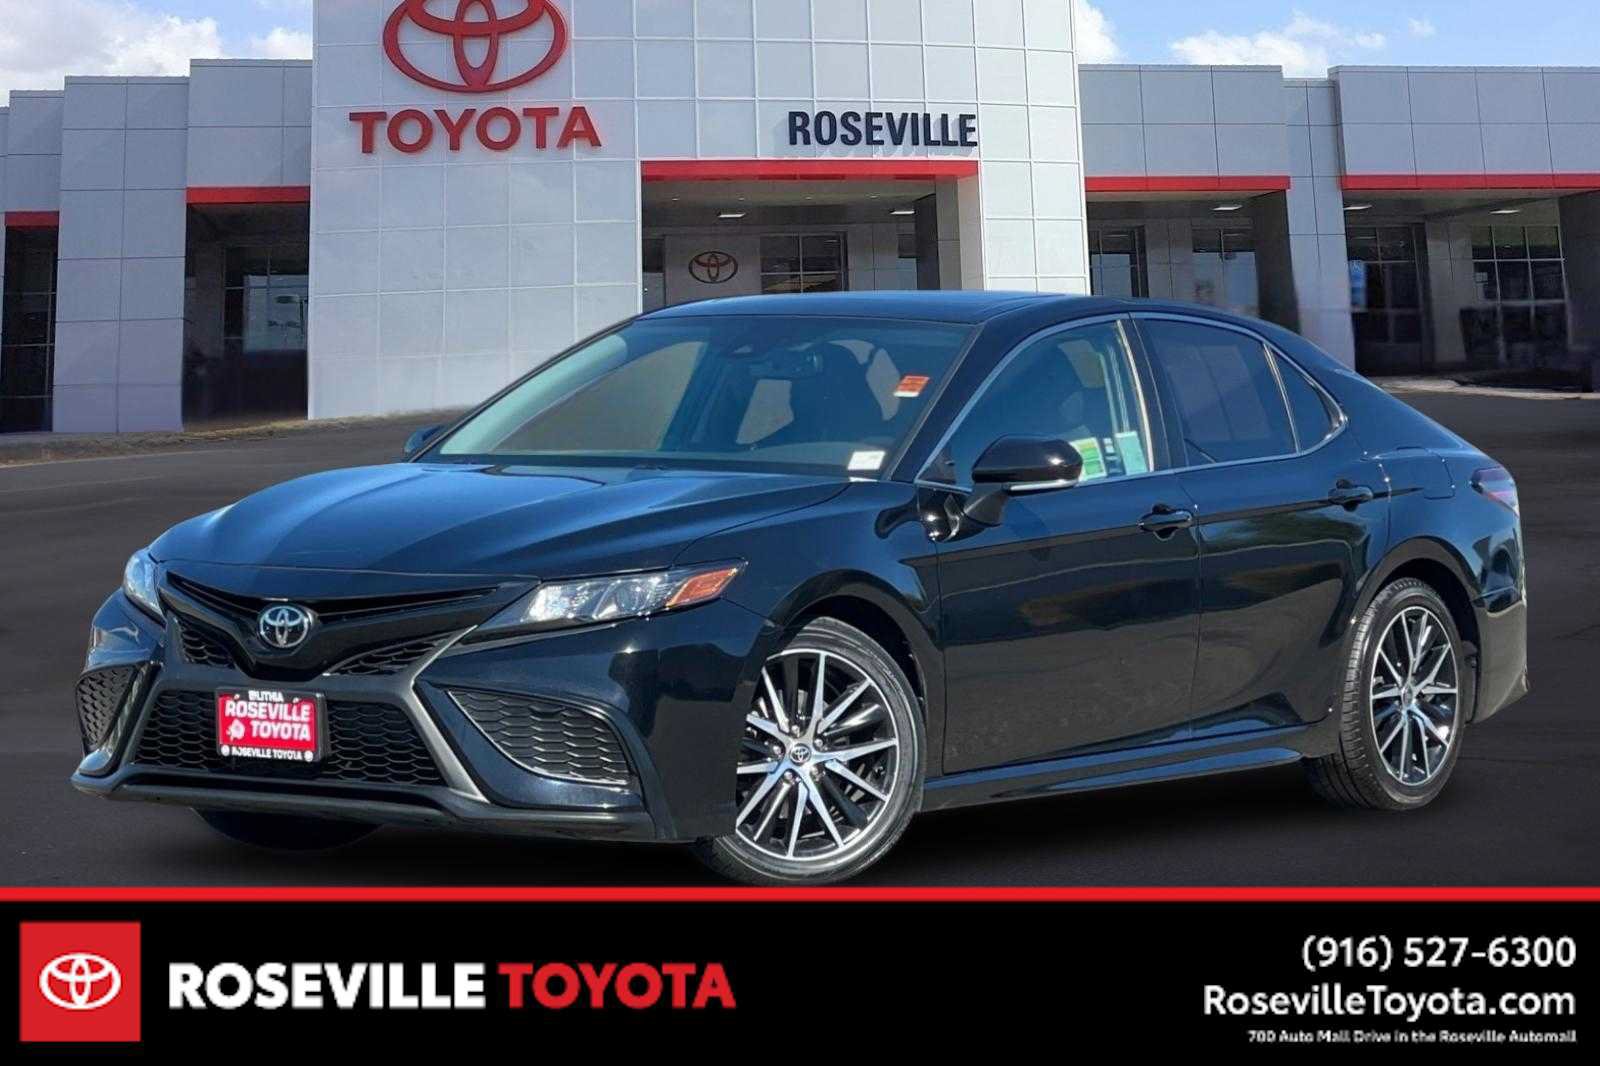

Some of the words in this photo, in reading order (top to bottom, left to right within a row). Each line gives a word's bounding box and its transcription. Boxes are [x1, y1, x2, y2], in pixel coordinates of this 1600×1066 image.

[350, 106, 603, 153] TOYOTA
[788, 110, 978, 147] ROSEVILLE
[225, 700, 311, 722] ROSEVILLE
[250, 720, 312, 742] TOYOTA
[272, 748, 303, 760] TOYOTA
